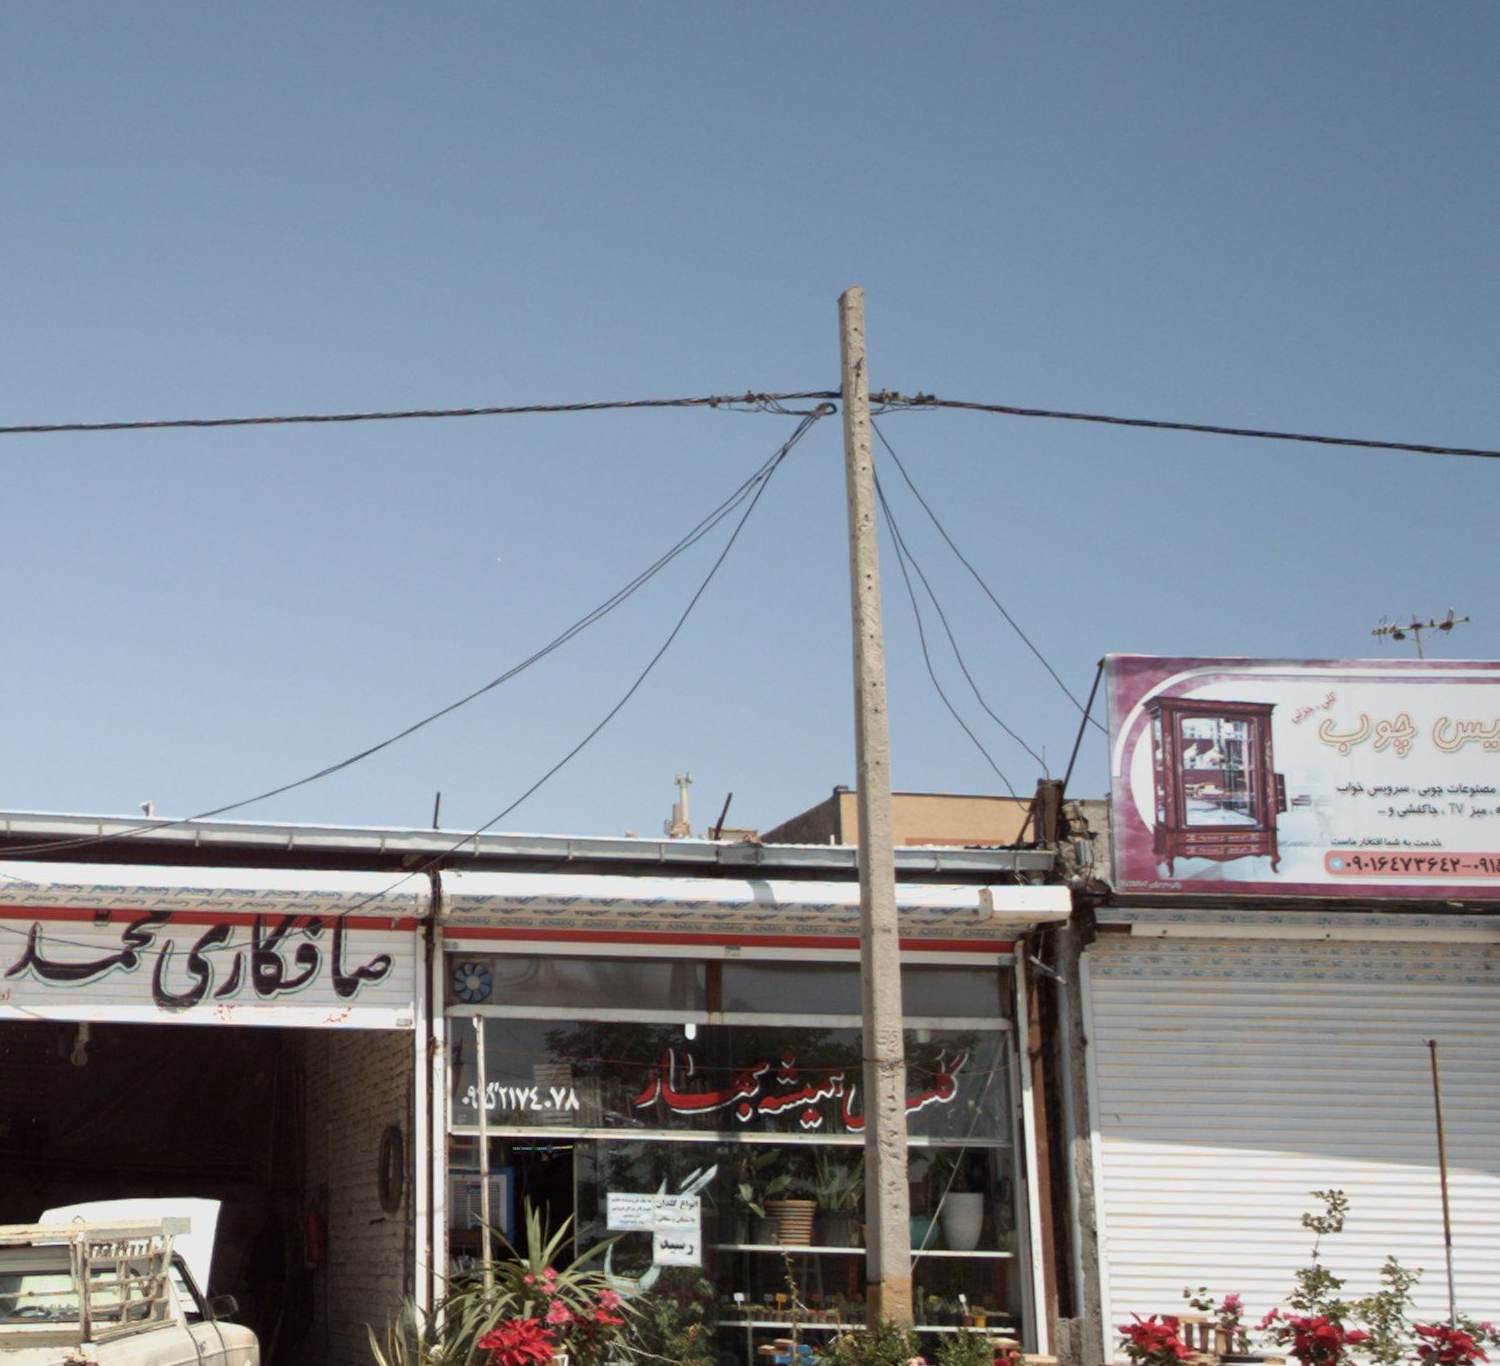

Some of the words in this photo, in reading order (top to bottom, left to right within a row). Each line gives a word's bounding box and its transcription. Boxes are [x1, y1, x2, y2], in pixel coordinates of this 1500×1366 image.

[1446, 782, 1497, 797] مصنوعات
[1448, 802, 1464, 815] TV
[152, 913, 396, 1014] صافکاری
[660, 1239, 694, 1256] رسید
